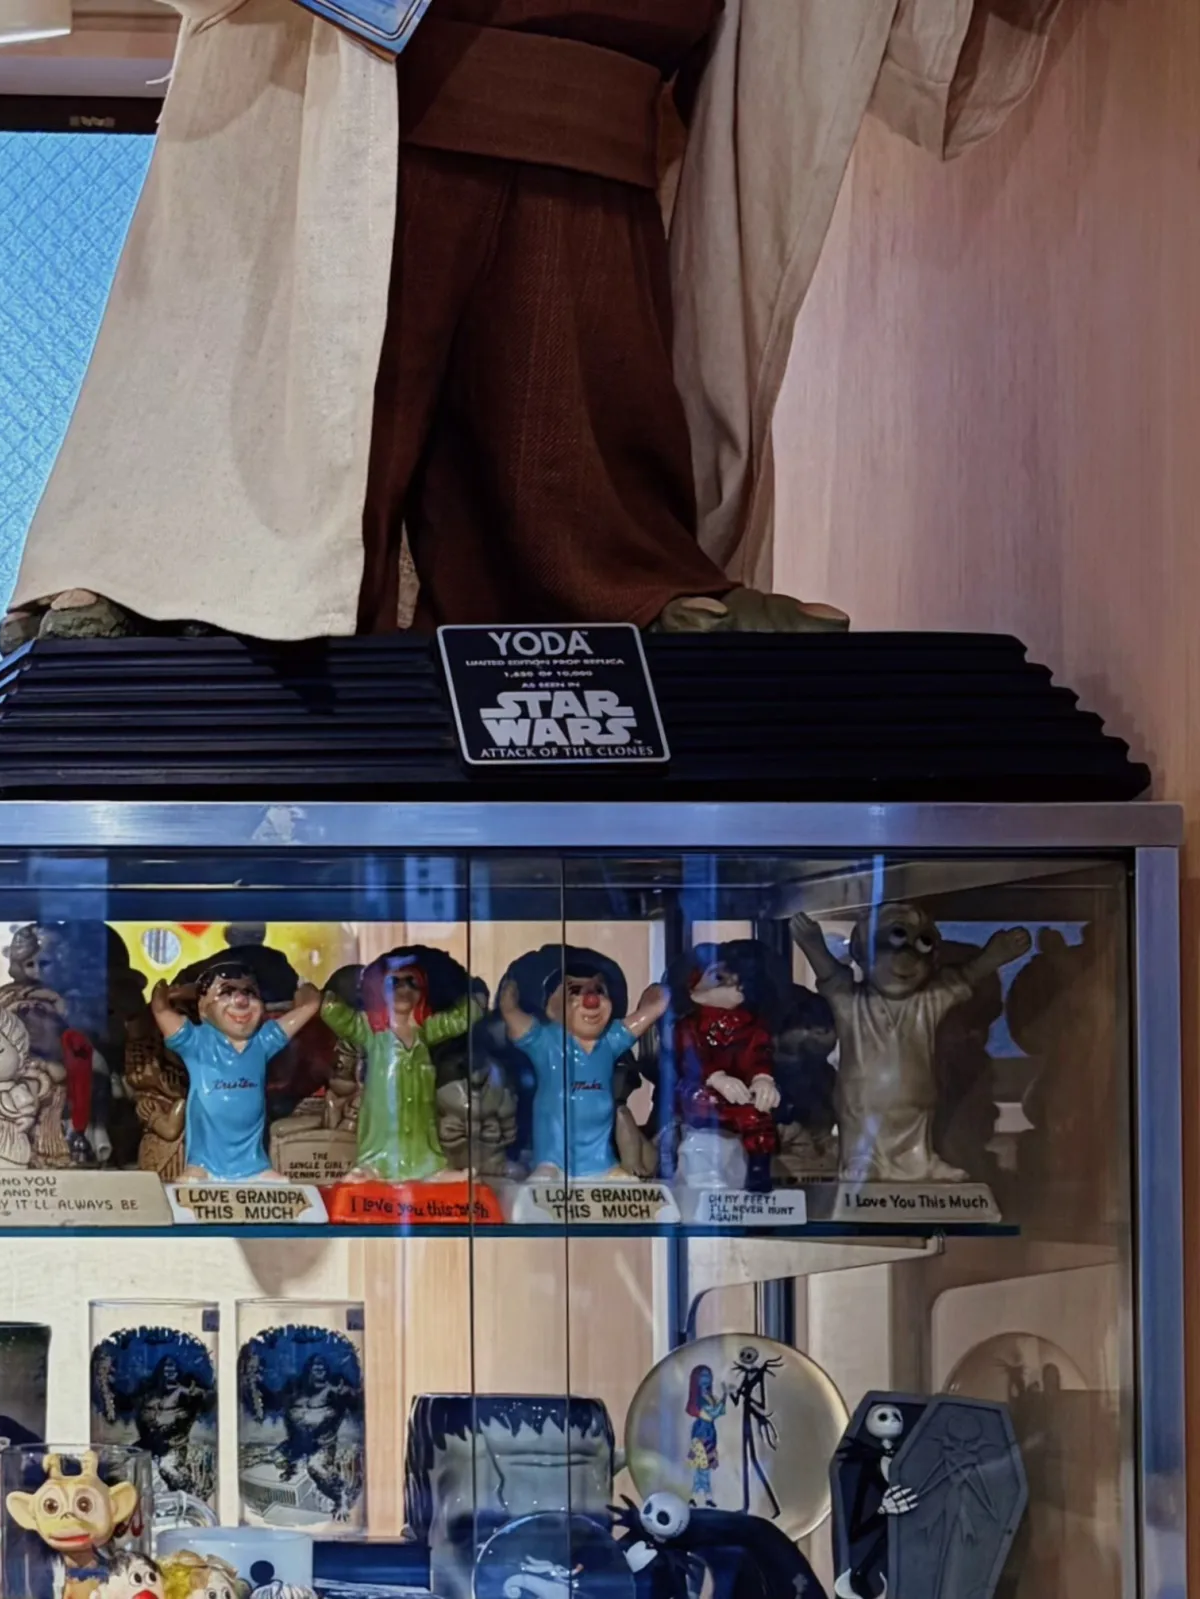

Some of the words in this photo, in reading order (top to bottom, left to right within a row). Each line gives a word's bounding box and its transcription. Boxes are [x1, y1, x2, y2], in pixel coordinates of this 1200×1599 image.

[488, 631, 594, 657] YODA
[479, 690, 634, 719] STAR
[482, 718, 637, 747] WARS
[480, 748, 536, 758] ATTACK
[540, 748, 559, 758] OF
[563, 747, 593, 757] THE
[597, 746, 654, 757] CLONES
[312, 1152, 328, 1160] THE
[289, 1161, 320, 1169] SINGLE
[23, 1176, 57, 1186] YOU
[3, 1188, 31, 1197] AND
[35, 1188, 58, 1197] ME
[188, 1190, 229, 1203] LOVE
[236, 1190, 306, 1204] GRANDPA
[546, 1189, 585, 1202] LOVE
[590, 1189, 666, 1203] GRANDMA
[58, 1200, 114, 1210] ALWAYS
[121, 1199, 138, 1210] BE
[363, 1197, 393, 1213] Love
[397, 1203, 424, 1217] you
[427, 1199, 453, 1216] this
[855, 1193, 886, 1208] Love
[892, 1194, 916, 1209] You
[919, 1193, 946, 1209] This
[949, 1193, 988, 1208] Much
[193, 1205, 233, 1219] THIS
[244, 1205, 294, 1219] MUCH
[552, 1204, 591, 1219] THIS
[601, 1205, 650, 1219] MUCH
[732, 1205, 763, 1214] NEVER
